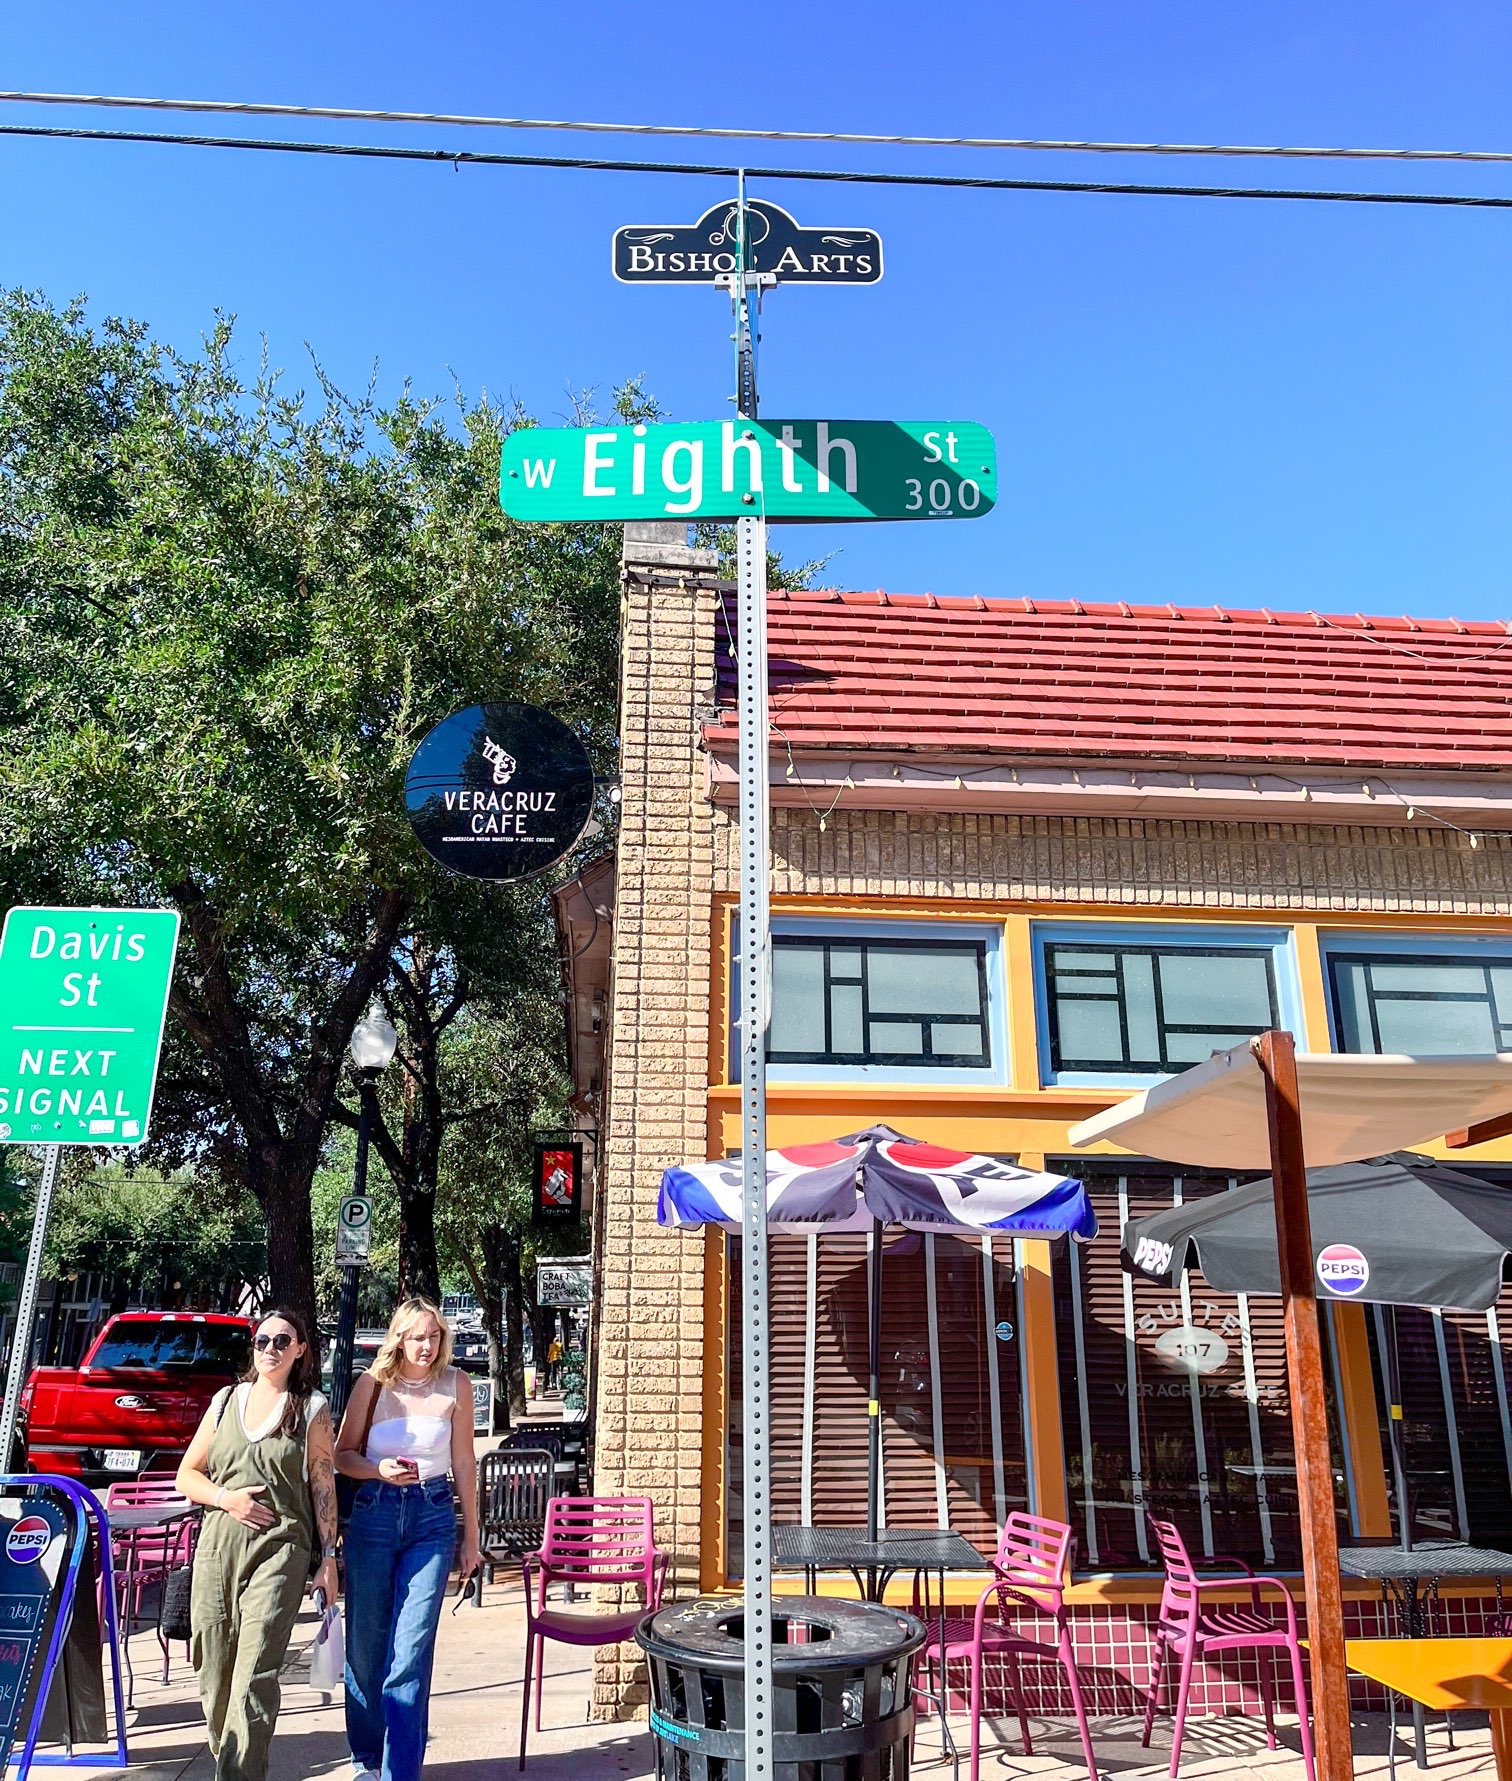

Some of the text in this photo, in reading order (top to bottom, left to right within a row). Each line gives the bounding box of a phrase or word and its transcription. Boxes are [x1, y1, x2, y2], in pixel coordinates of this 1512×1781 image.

[627, 245, 873, 274] BISHO ARTS
[522, 421, 959, 514] W Eighth St
[905, 478, 980, 511] 300
[444, 790, 556, 812] VERACRUZ
[471, 813, 527, 834] CAFE
[29, 924, 147, 962] Davis
[59, 972, 102, 1007] St
[18, 1049, 117, 1077] NEXT
[1133, 1236, 1175, 1275] PEPSI
[1321, 1263, 1365, 1275] PEPSI
[542, 1272, 571, 1281] CRAFT
[542, 1282, 567, 1291] BOBA
[1138, 1300, 1243, 1336] SUTE
[1176, 1343, 1211, 1357] 107
[8, 1534, 48, 1546] PEPSI
